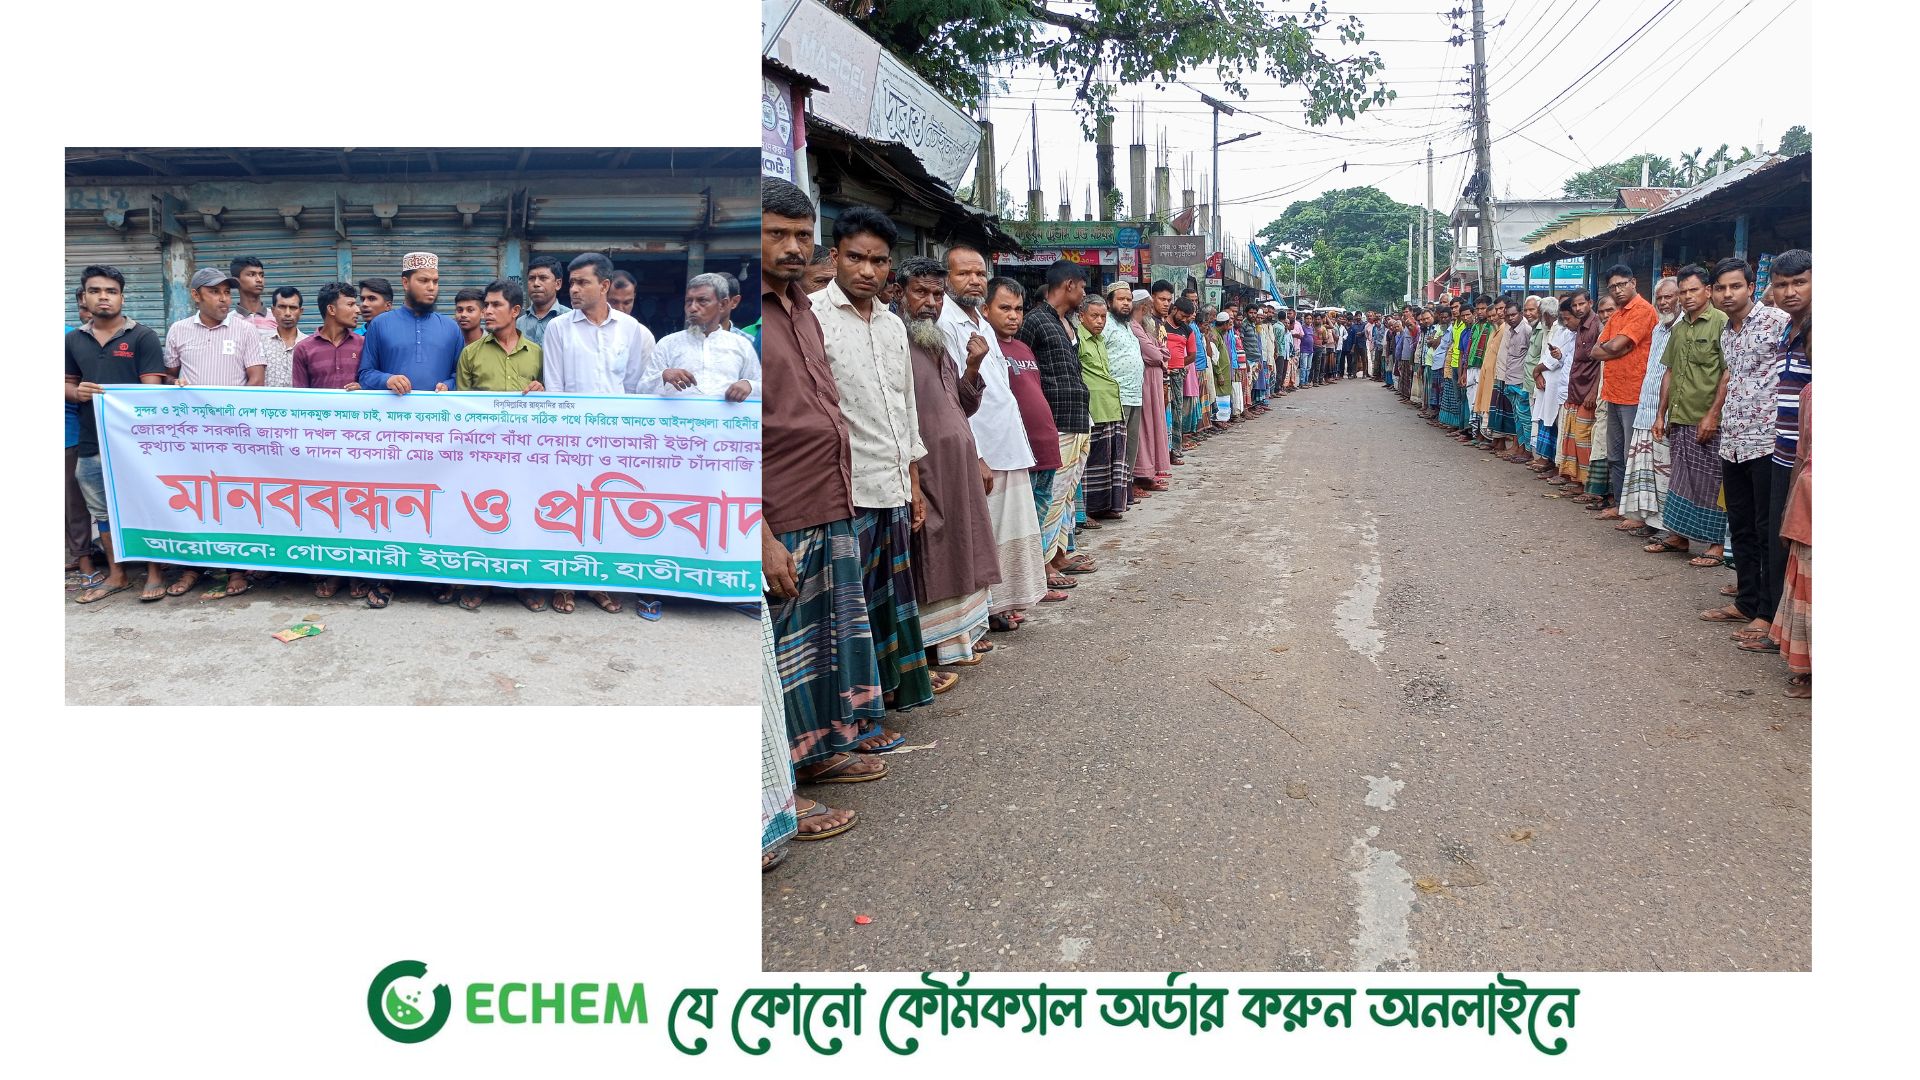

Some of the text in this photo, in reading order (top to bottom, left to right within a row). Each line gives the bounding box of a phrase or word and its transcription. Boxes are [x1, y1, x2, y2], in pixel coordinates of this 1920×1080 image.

[134, 406, 157, 417] সুন্দর
[161, 406, 169, 414] ও
[172, 402, 189, 417] সুখী
[192, 403, 236, 419] সমৃদ্ধিশালী
[238, 407, 257, 417] দেশ
[261, 408, 288, 419] গড়তে
[290, 408, 332, 421] মাদকমুক্ত
[334, 409, 361, 420] সমাজ
[386, 410, 413, 421] মাদক
[415, 409, 450, 422] ব্যবসায়ী
[454, 413, 462, 422] ও
[464, 410, 529, 424] সেবনকারীদের
[531, 410, 558, 424] সঠিক
[561, 414, 581, 425] পথে
[585, 412, 619, 426] ফিরিয়ে
[621, 415, 656, 427] আনতে
[722, 416, 760, 430] বাহিনীর
[131, 421, 199, 438] জোরপূর্বক
[202, 422, 253, 438] সরকারি
[256, 427, 300, 439] জায়গা
[303, 428, 337, 440] দখল
[340, 429, 372, 442] করে
[376, 430, 444, 443] দোকানঘর
[448, 428, 496, 445] নির্মাণে
[501, 429, 532, 447] বাঁধা
[537, 434, 581, 448] দেয়ায়
[586, 433, 660, 450] গোতামারী
[664, 434, 708, 452] ইউপি
[138, 440, 187, 455] কুখ্যাত
[190, 442, 229, 454] মাদক
[232, 441, 285, 456] ব্যবসায়ী
[289, 446, 300, 456] ও
[305, 446, 343, 459] দাদন
[346, 444, 402, 460] ব্যবসায়ী
[406, 449, 434, 461] মোঃ
[469, 449, 522, 464] গফফার
[527, 452, 551, 464] এর
[555, 449, 594, 466] মিথ্যা
[599, 456, 611, 466] ও
[617, 454, 683, 469] বানোয়াট
[688, 454, 755, 472] চাঁদাবাজি
[156, 470, 444, 537] মানববন্ধন
[461, 489, 512, 534] ও
[287, 543, 411, 568] গোতামারী
[419, 547, 532, 577] ইউনিয়ন
[541, 554, 610, 581] বাসী,
[616, 560, 756, 592] হাতীবান্ধা,
